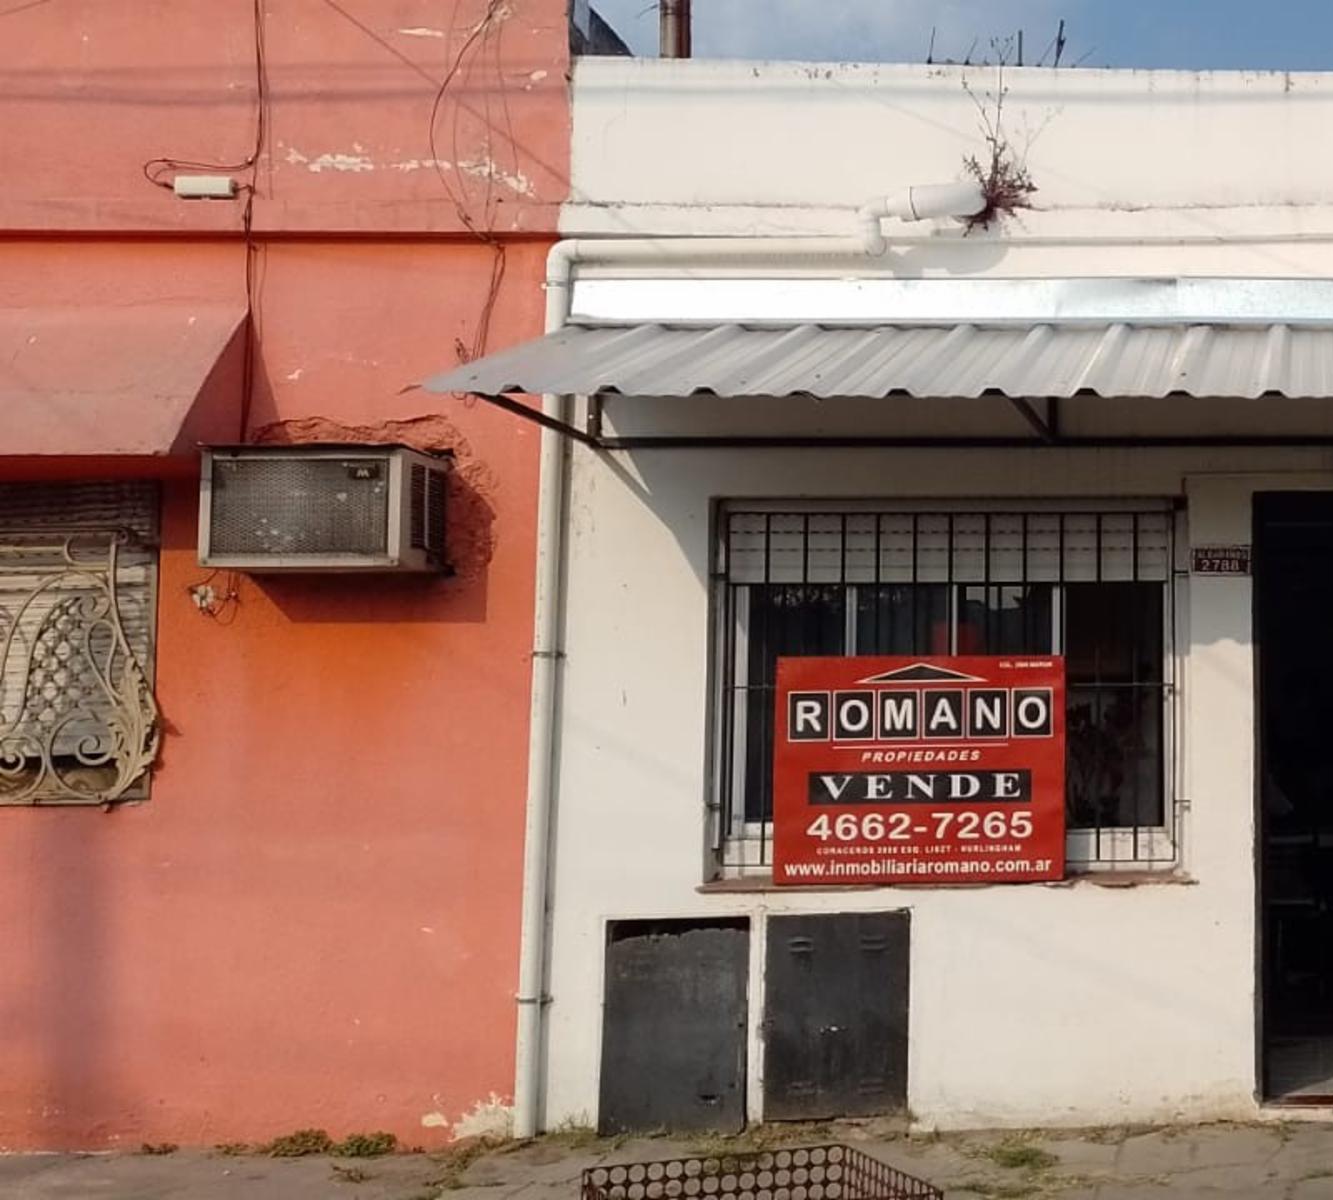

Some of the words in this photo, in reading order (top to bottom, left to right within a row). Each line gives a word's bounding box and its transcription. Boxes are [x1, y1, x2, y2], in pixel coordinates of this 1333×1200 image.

[795, 696, 1048, 732] ROMANO
[861, 750, 981, 763] PROPIEDADES
[819, 773, 1022, 800] VENDE
[806, 811, 1033, 841] 4662-7265
[784, 858, 1053, 877] www.inmobiliariaromano.com.ar
